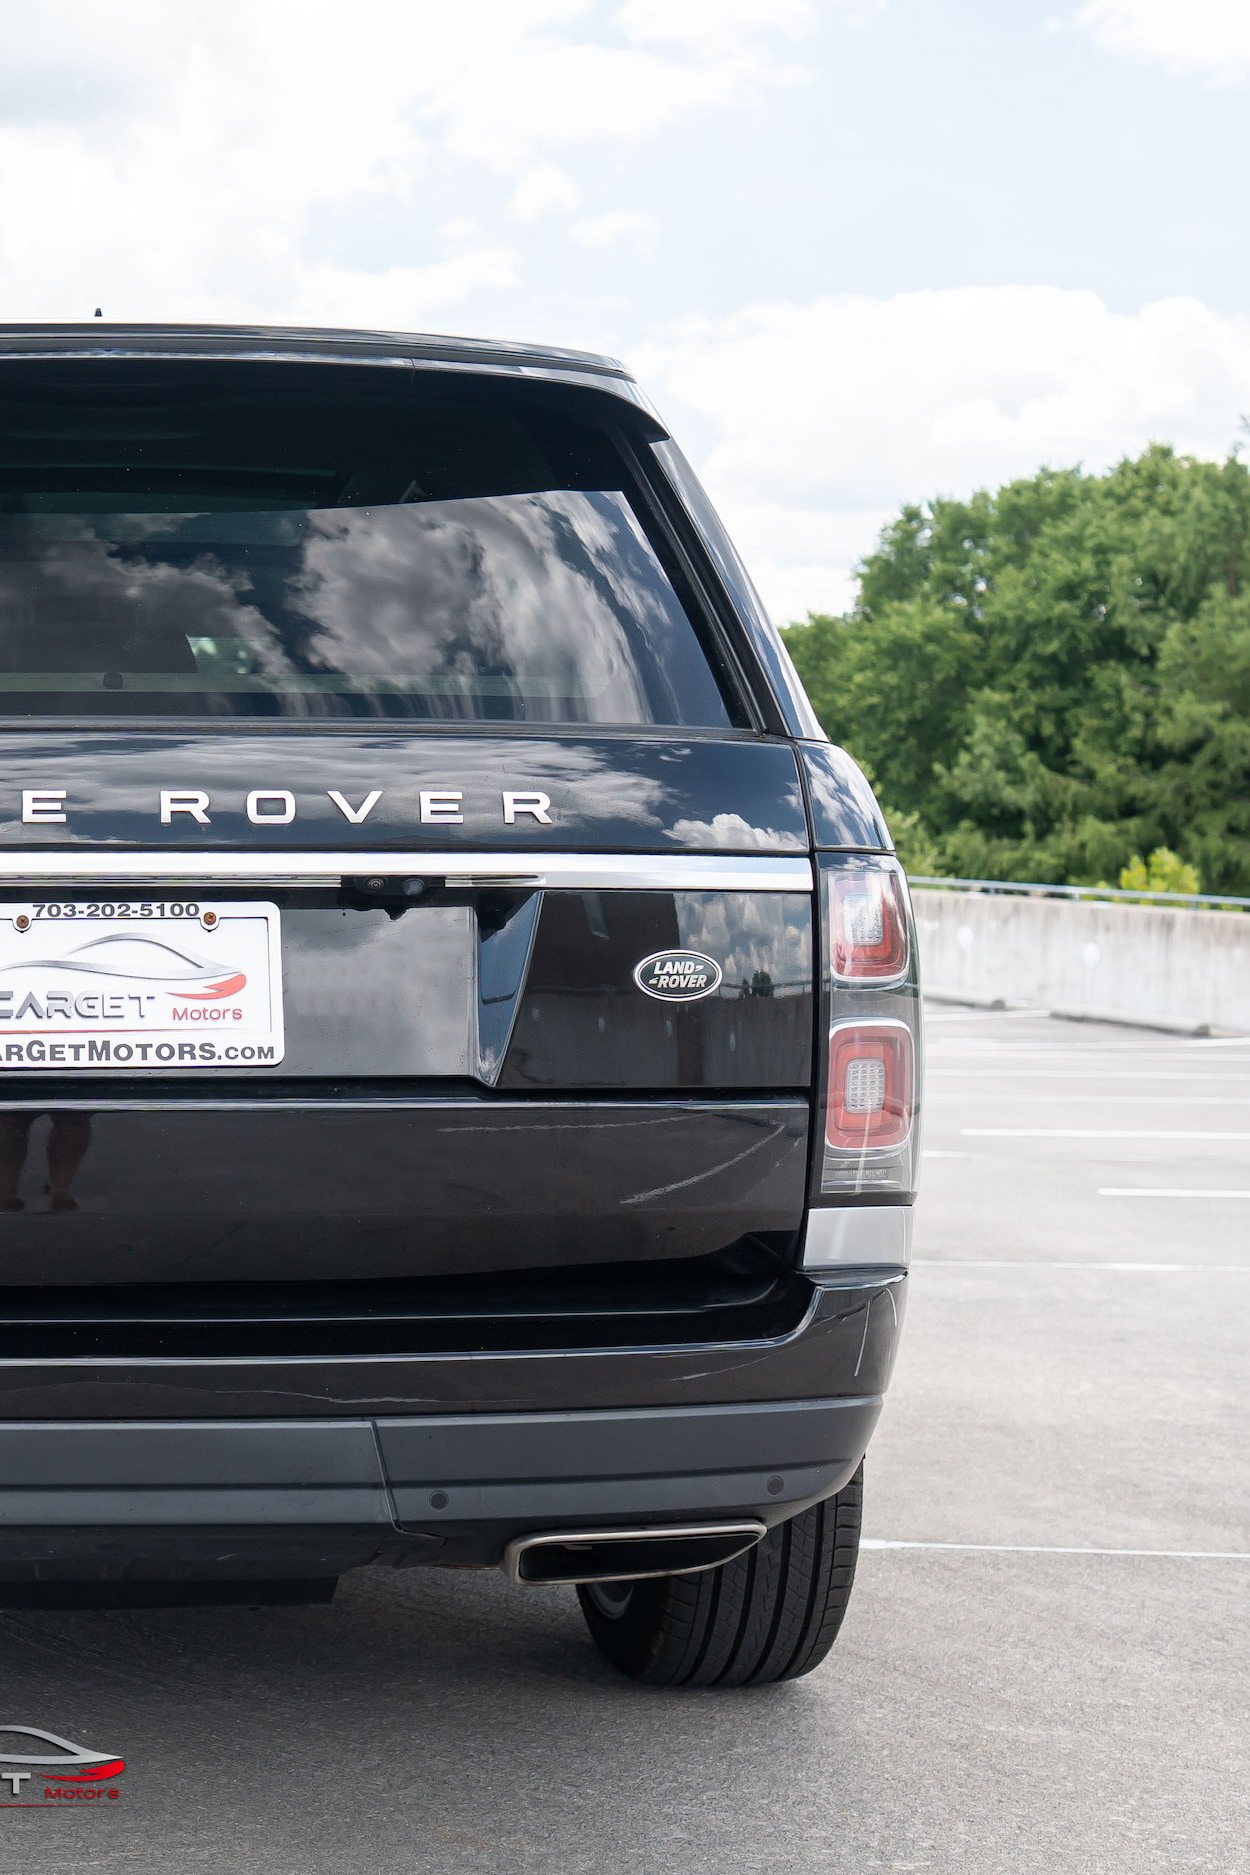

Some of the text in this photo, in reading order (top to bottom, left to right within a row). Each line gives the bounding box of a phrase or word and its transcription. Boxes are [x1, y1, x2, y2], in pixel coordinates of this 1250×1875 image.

[160, 790, 554, 824] ROVER
[32, 903, 200, 917] 703-202-5100
[654, 961, 695, 975] LAND
[657, 975, 708, 988] ROVER
[172, 1006, 243, 1021] Motors
